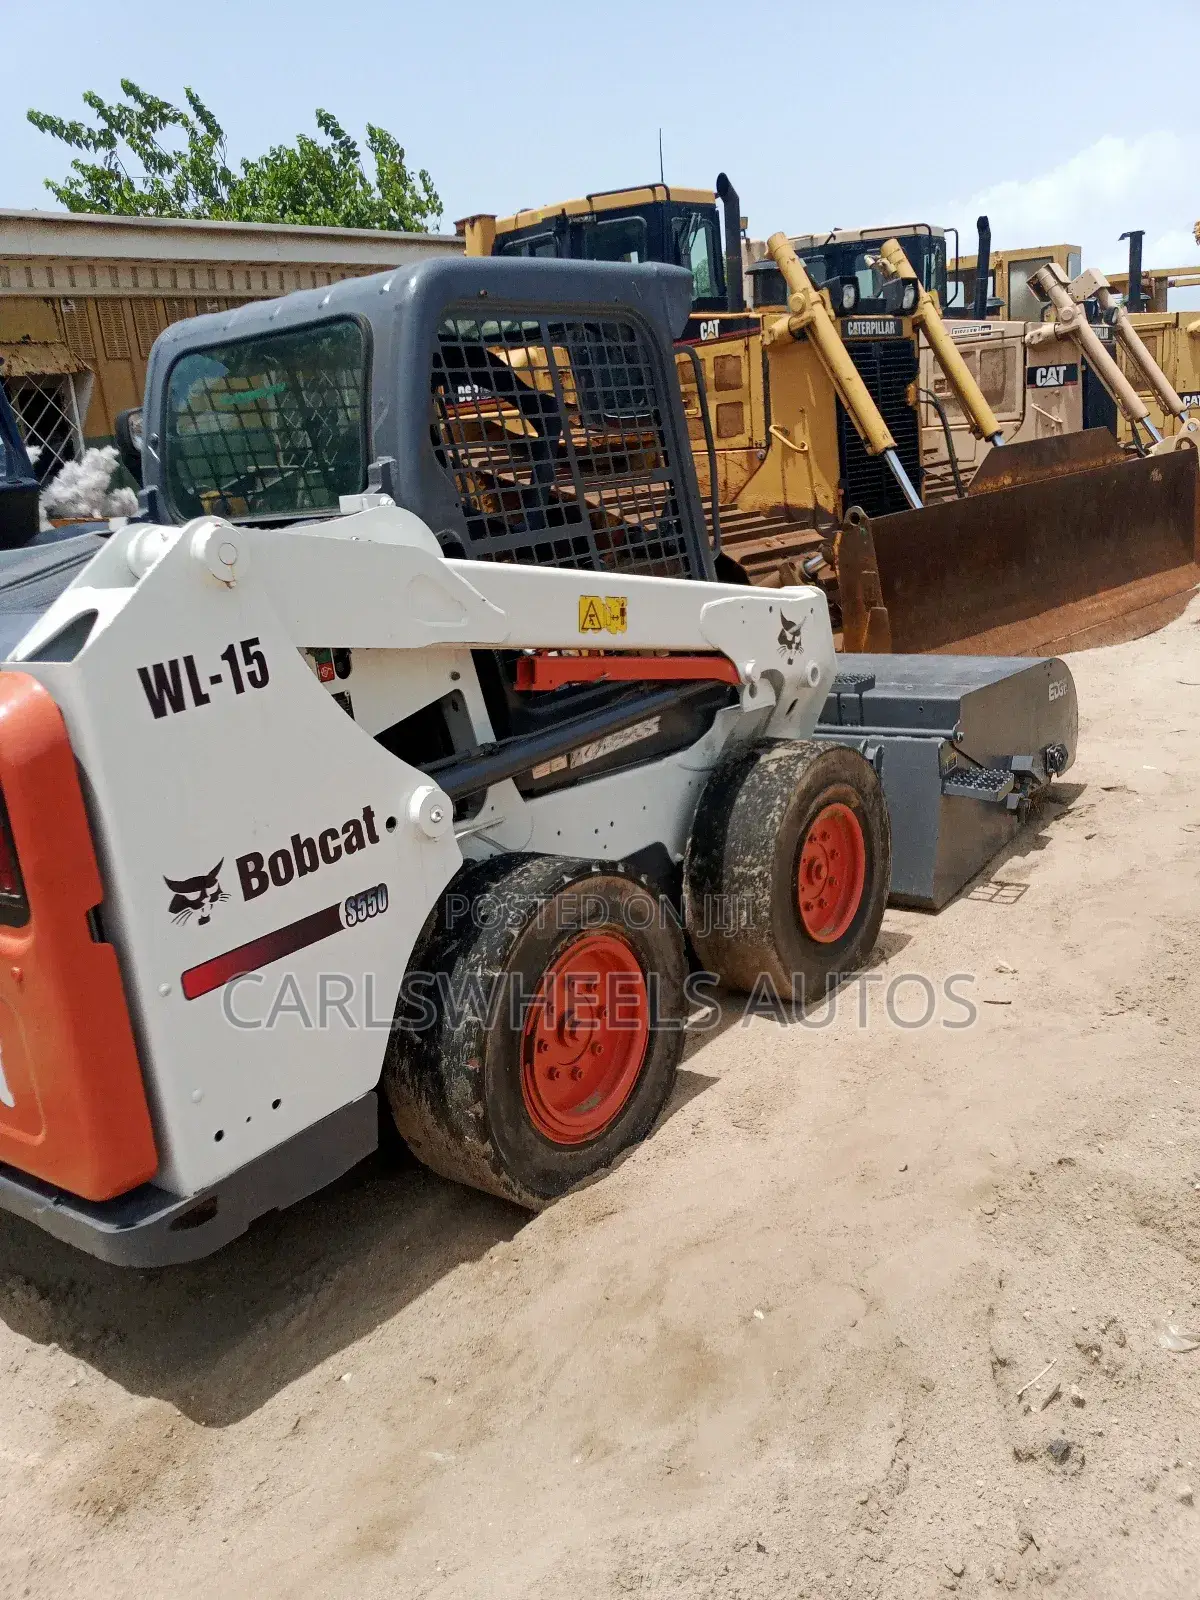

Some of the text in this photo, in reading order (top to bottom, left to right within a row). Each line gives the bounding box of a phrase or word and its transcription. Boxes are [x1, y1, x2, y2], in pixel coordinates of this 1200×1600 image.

[700, 319, 719, 340] CAT
[848, 321, 896, 335] CATERPILLAR
[1036, 366, 1067, 386] CAT
[137, 637, 269, 719] WL-15
[235, 805, 380, 901] Bobcat
[345, 883, 388, 927] S550
